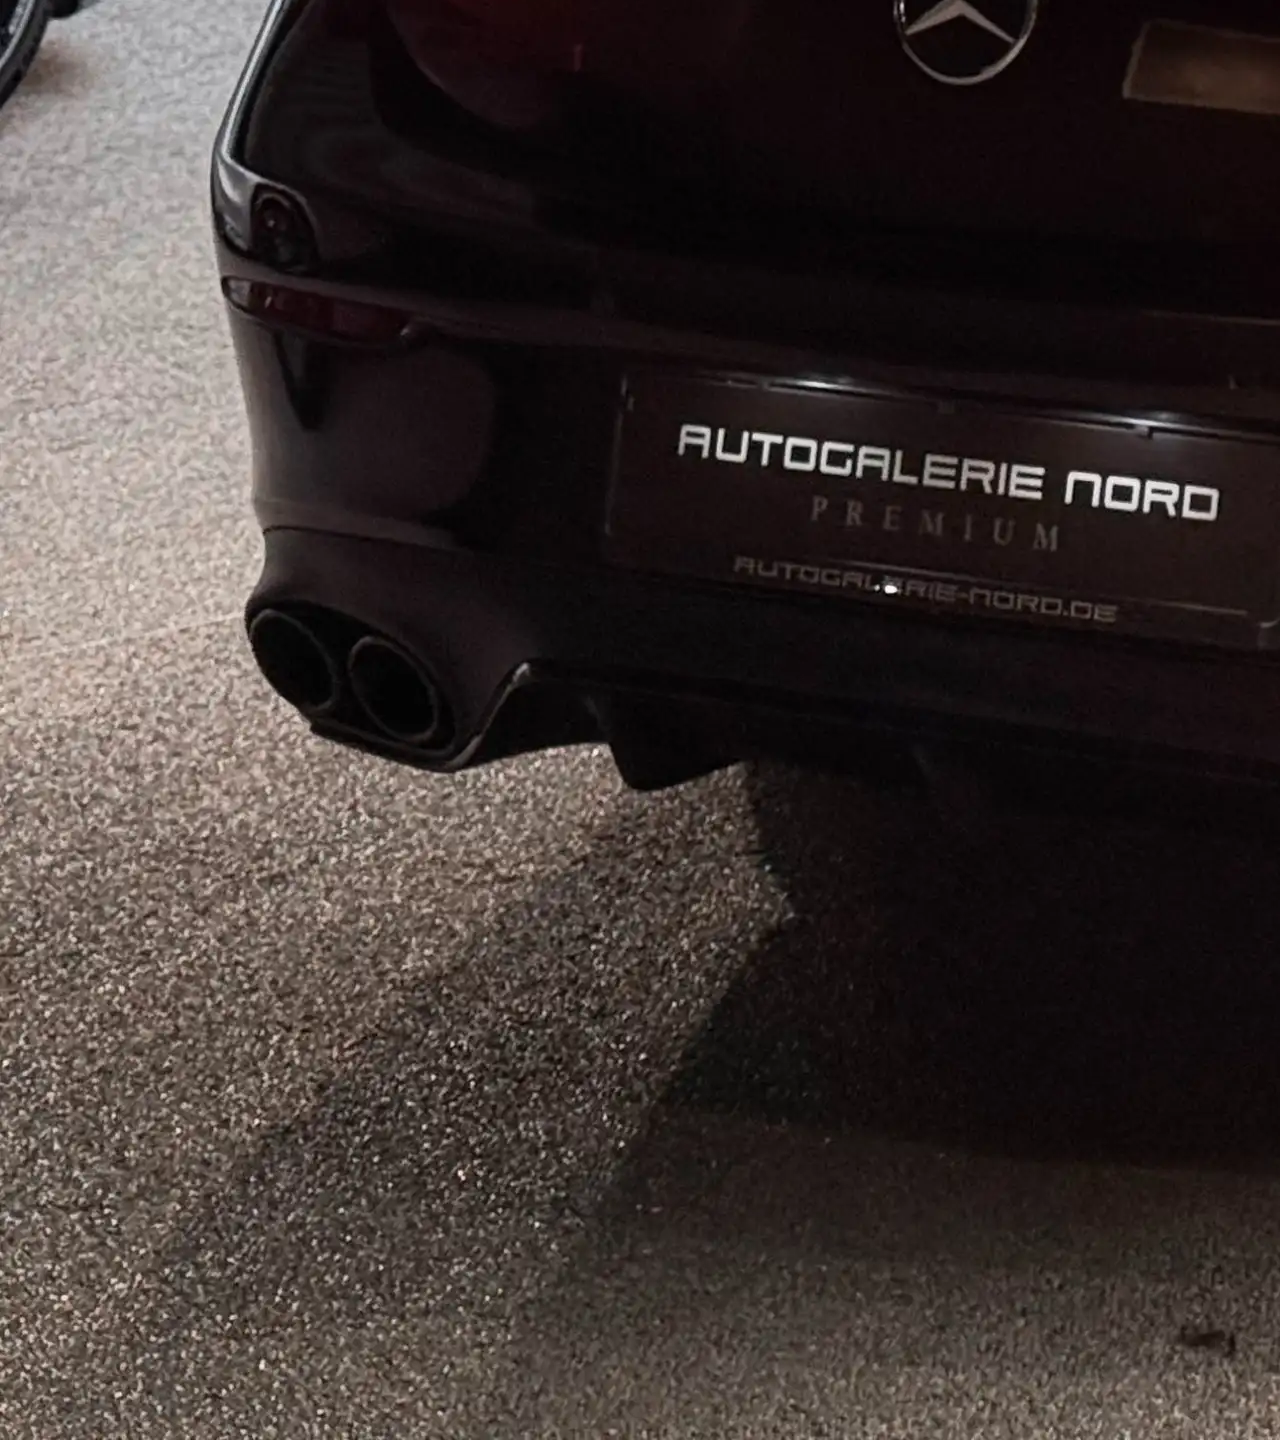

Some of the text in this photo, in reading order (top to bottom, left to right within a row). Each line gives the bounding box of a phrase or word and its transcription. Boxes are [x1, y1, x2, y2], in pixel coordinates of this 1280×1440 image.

[677, 423, 1220, 521] AUTOGALERIE NORD
[811, 493, 1060, 553] PREMIUM
